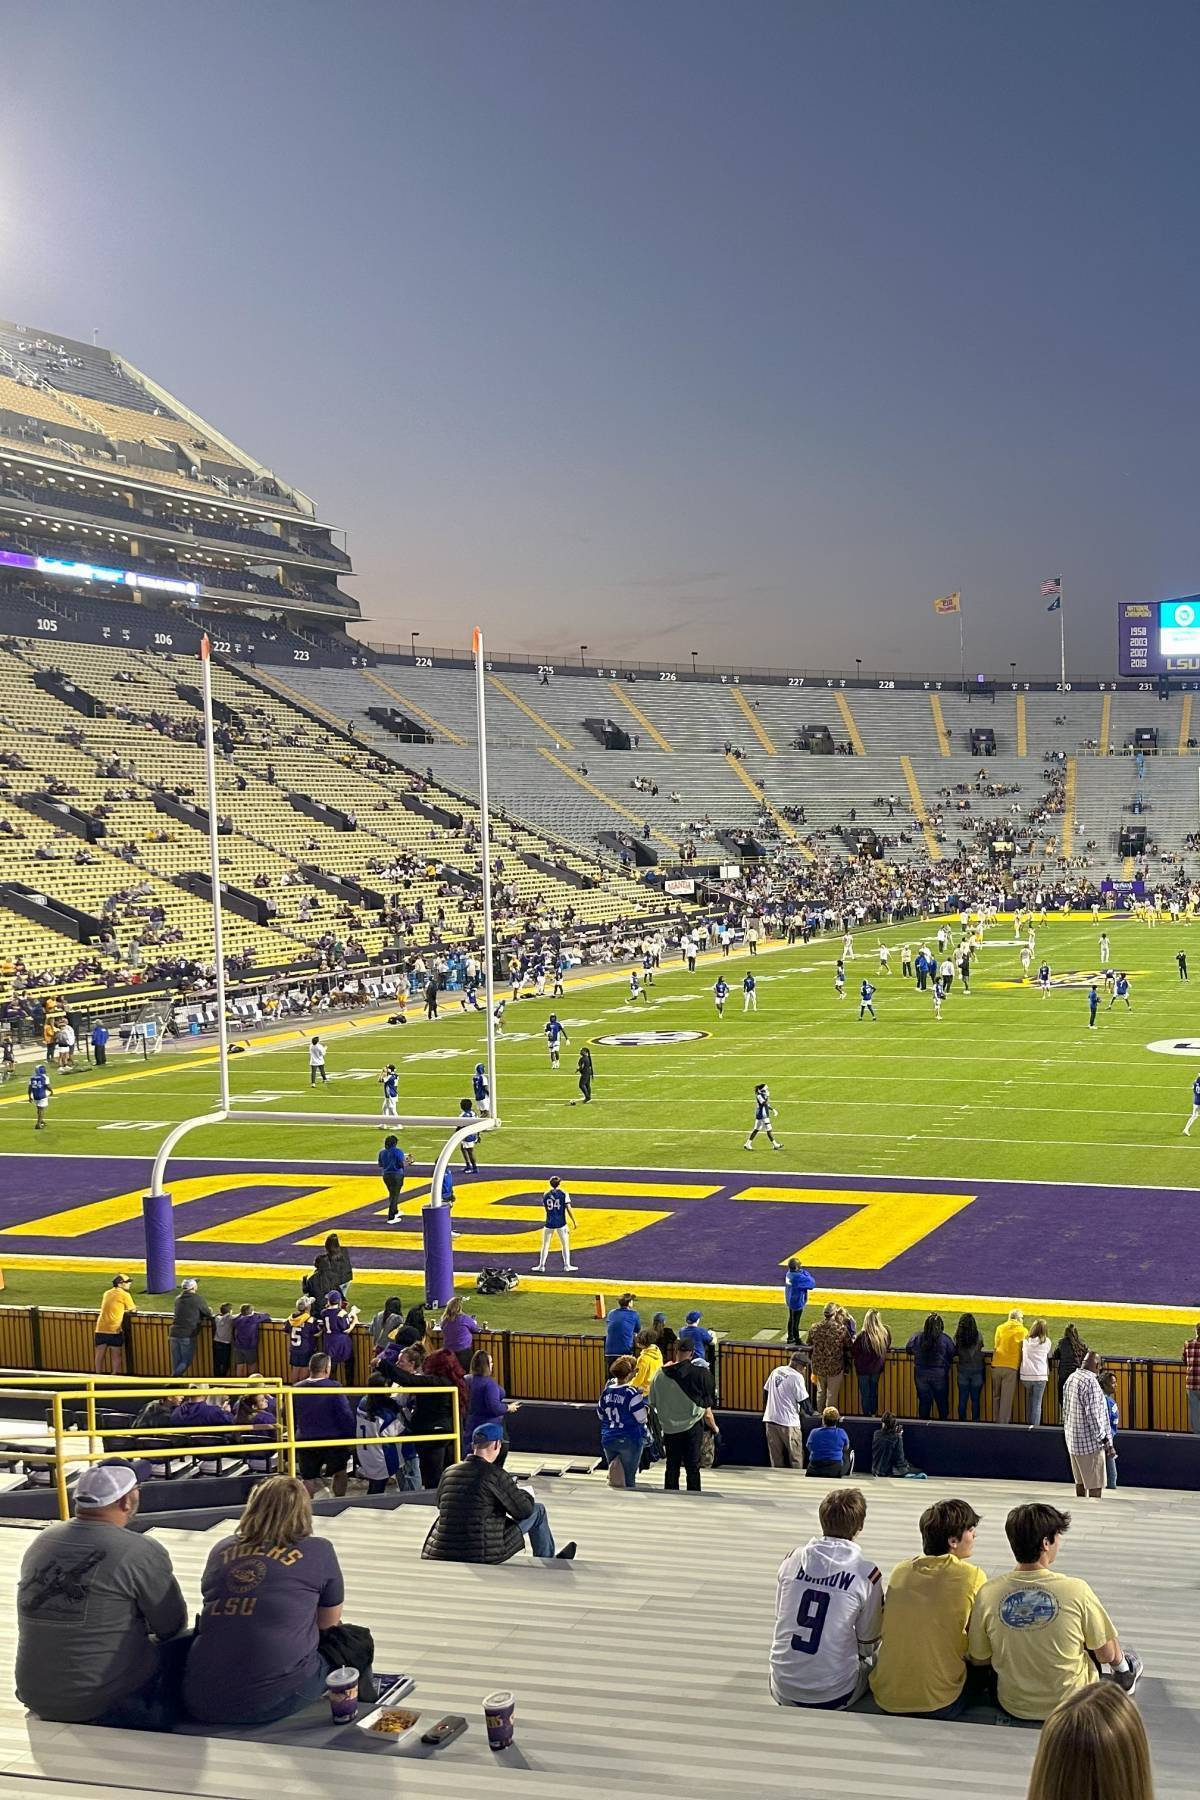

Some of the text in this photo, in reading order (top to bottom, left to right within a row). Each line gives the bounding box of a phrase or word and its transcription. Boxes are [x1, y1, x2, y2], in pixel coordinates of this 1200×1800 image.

[37, 619, 58, 632] 105
[1130, 627, 1147, 635] 1958
[154, 633, 173, 646] 106
[1130, 638, 1148, 646] 2003
[212, 641, 231, 653] 222
[1130, 648, 1148, 657] 2007
[293, 650, 310, 661] 223
[415, 657, 433, 668] 224
[1130, 659, 1147, 668] 2019
[1166, 658, 1200, 670] LSU
[659, 672, 677, 682] 226
[788, 677, 804, 687] 227
[878, 680, 895, 689] 228
[1138, 682, 1153, 691] 231
[31, 1080, 43, 1089] 24
[546, 1198, 561, 1211] 94
[324, 1316, 332, 1334] 1
[291, 1326, 302, 1347] 5
[604, 1406, 625, 1429] 11
[210, 1597, 257, 1616] LSU
[790, 1588, 831, 1656] 9
